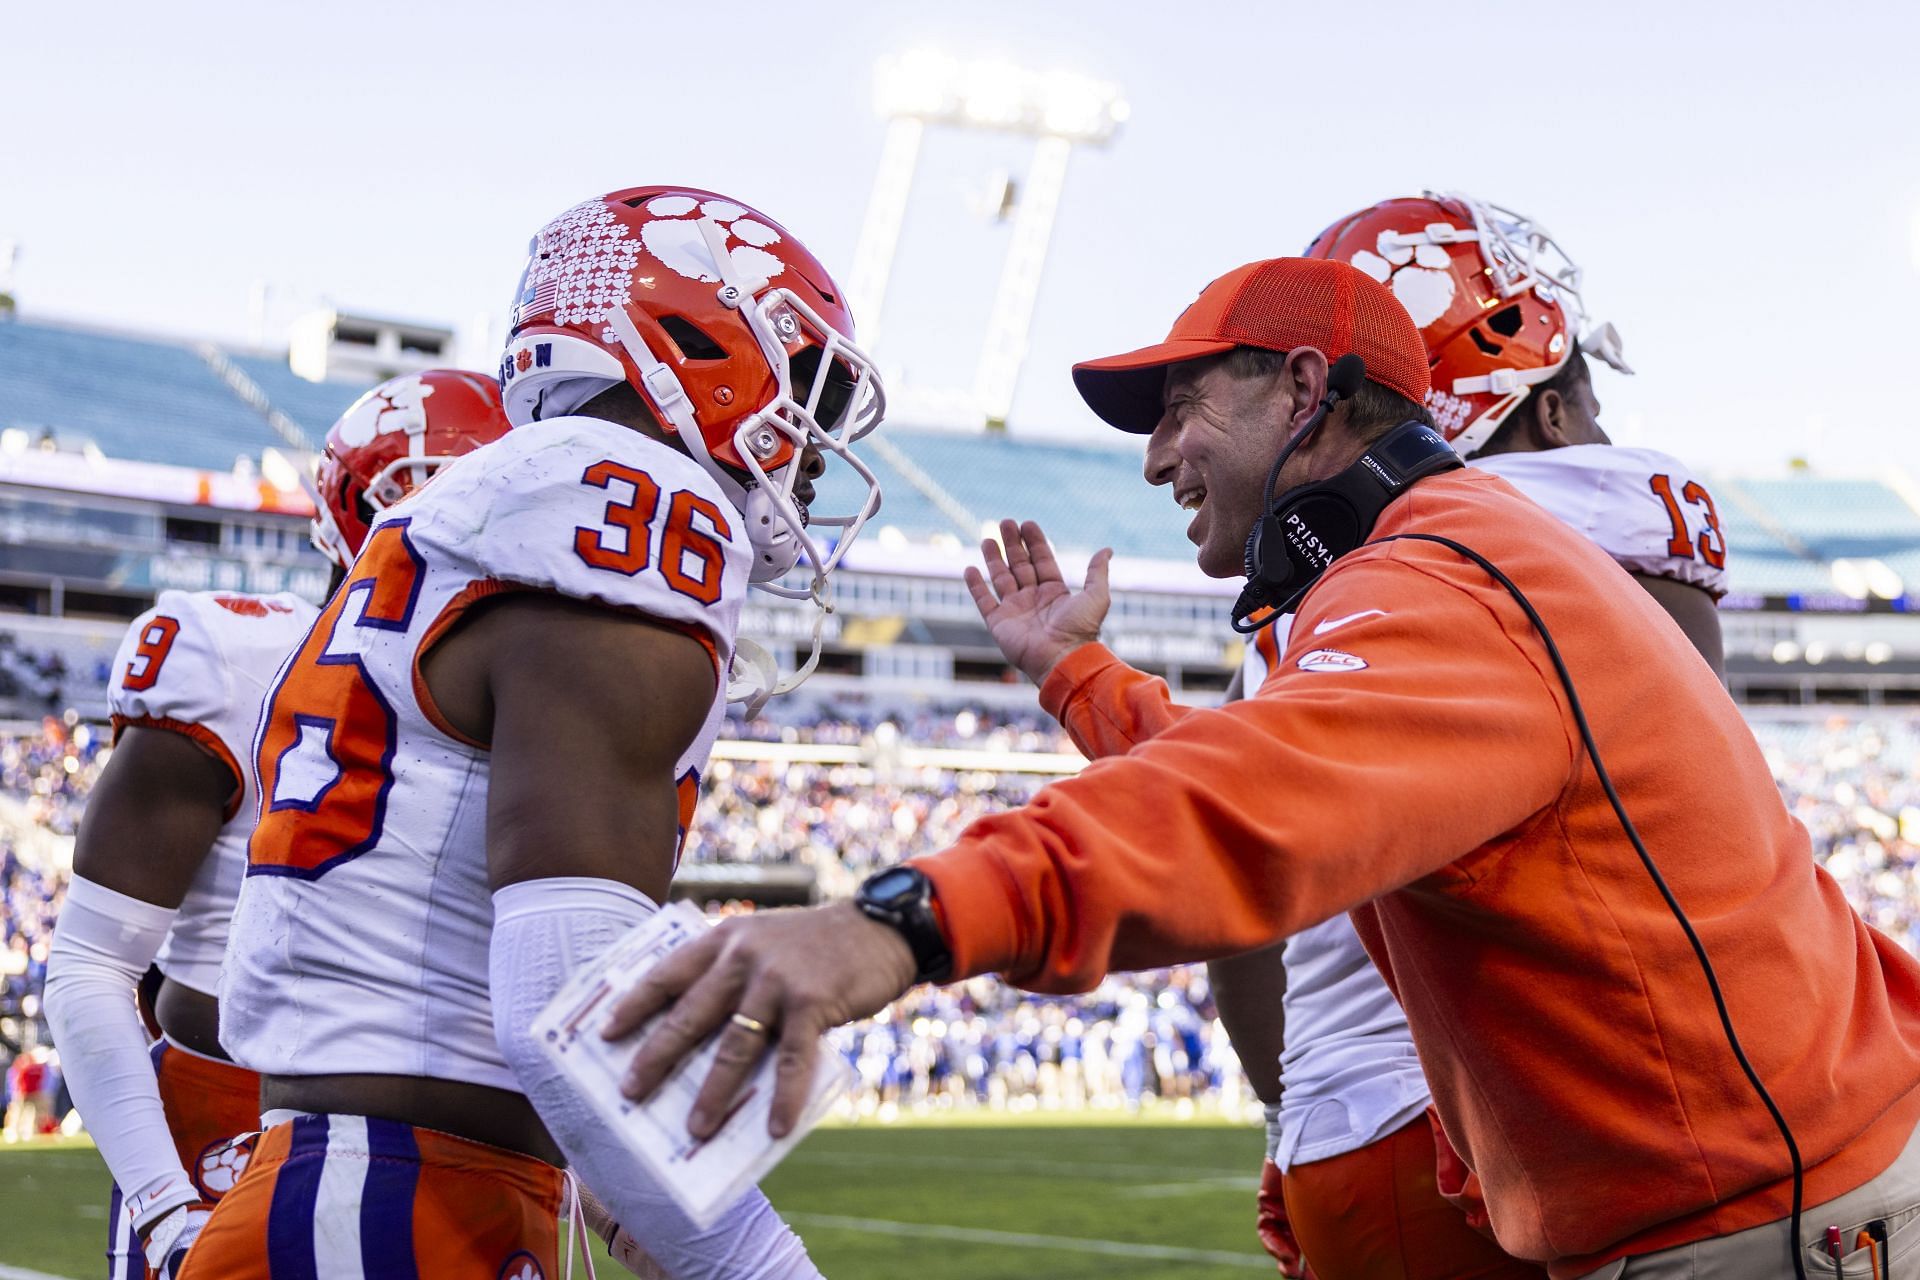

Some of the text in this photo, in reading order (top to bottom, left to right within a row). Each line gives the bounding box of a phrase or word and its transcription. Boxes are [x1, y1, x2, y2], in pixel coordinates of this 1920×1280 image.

[574, 459, 733, 607] 36
[1286, 513, 1334, 567] PRISMA
[1286, 531, 1318, 567] HEALTH
[1649, 473, 1726, 570] 13
[123, 615, 188, 701] 9
[1306, 653, 1359, 666] ACC
